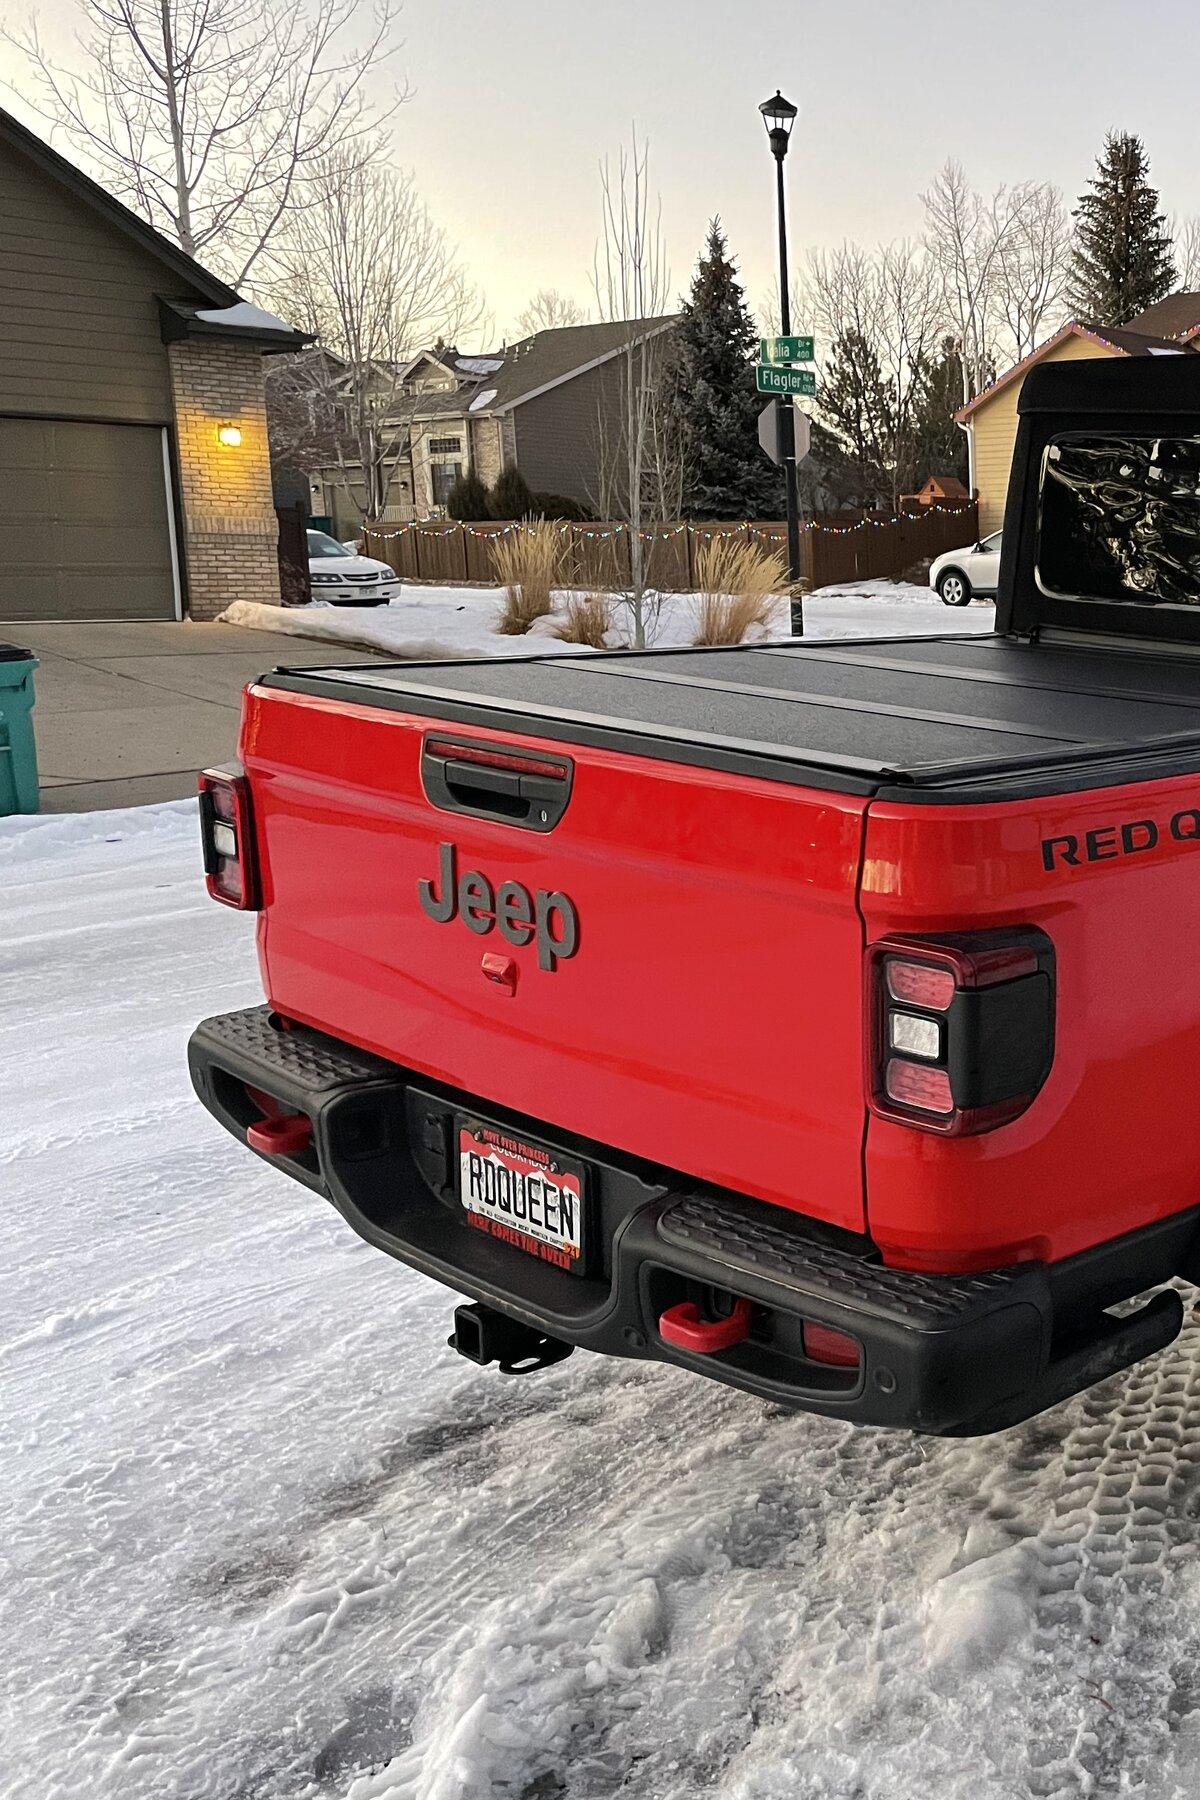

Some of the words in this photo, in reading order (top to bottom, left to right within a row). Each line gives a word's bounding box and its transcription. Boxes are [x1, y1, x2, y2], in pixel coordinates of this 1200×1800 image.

[763, 370, 801, 391] Flagler
[1041, 819, 1160, 872] RED
[417, 841, 580, 972] Jeep
[469, 1151, 574, 1241] RDQUEEN
